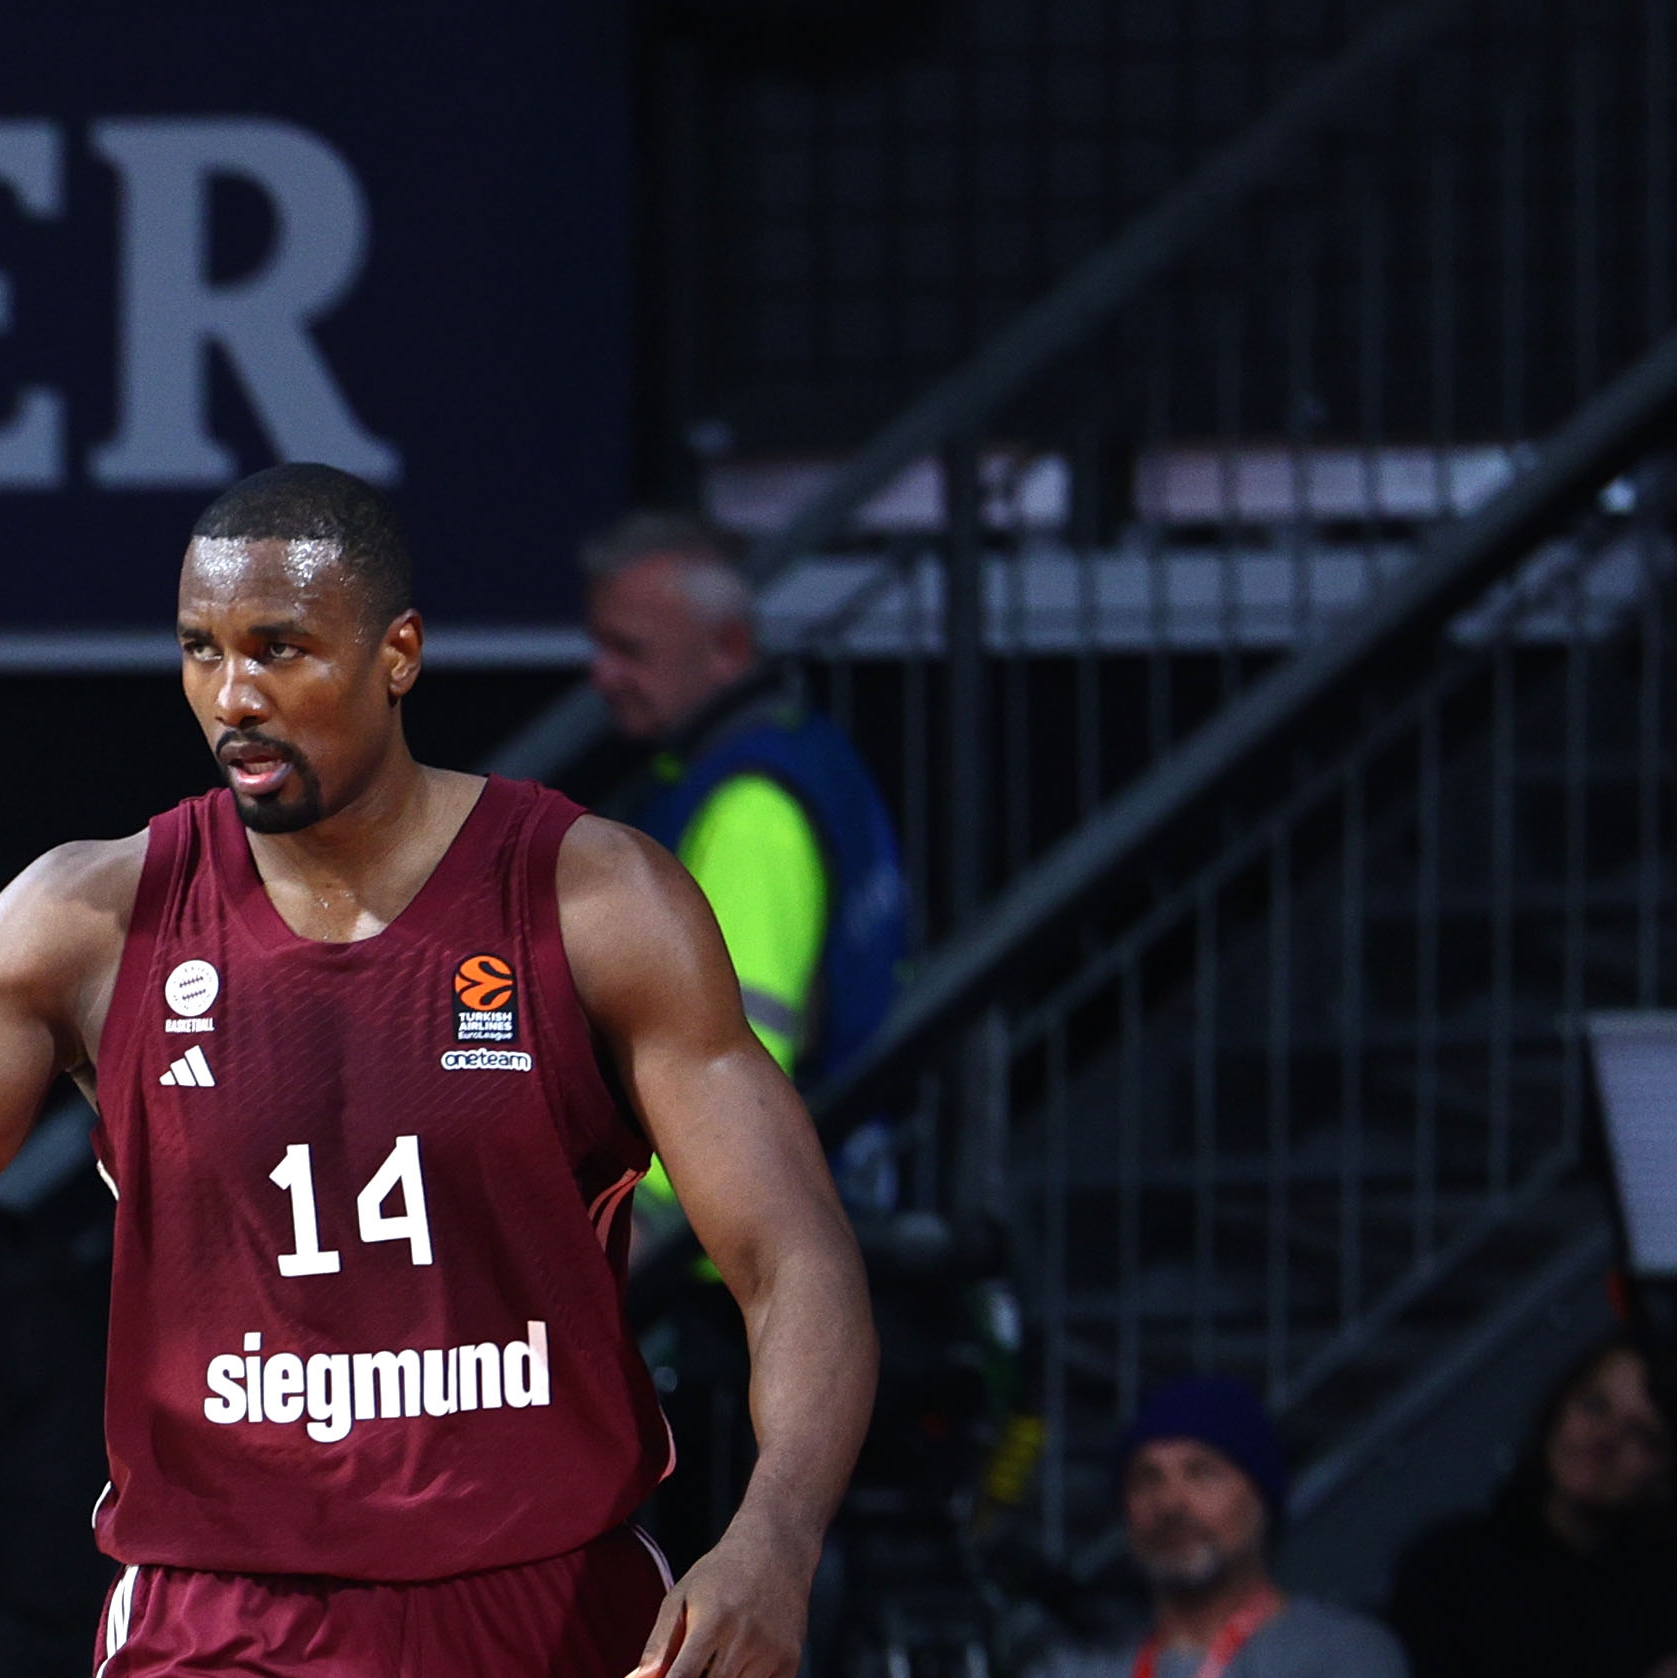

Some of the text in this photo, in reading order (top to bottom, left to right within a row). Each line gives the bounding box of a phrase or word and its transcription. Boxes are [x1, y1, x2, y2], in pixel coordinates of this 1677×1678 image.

[458, 1012, 513, 1022] TURKISH
[458, 1021, 513, 1031] AIRLINES
[444, 1050, 530, 1069] oneteam
[269, 1134, 434, 1277] 14
[203, 1320, 550, 1443] siegmund
